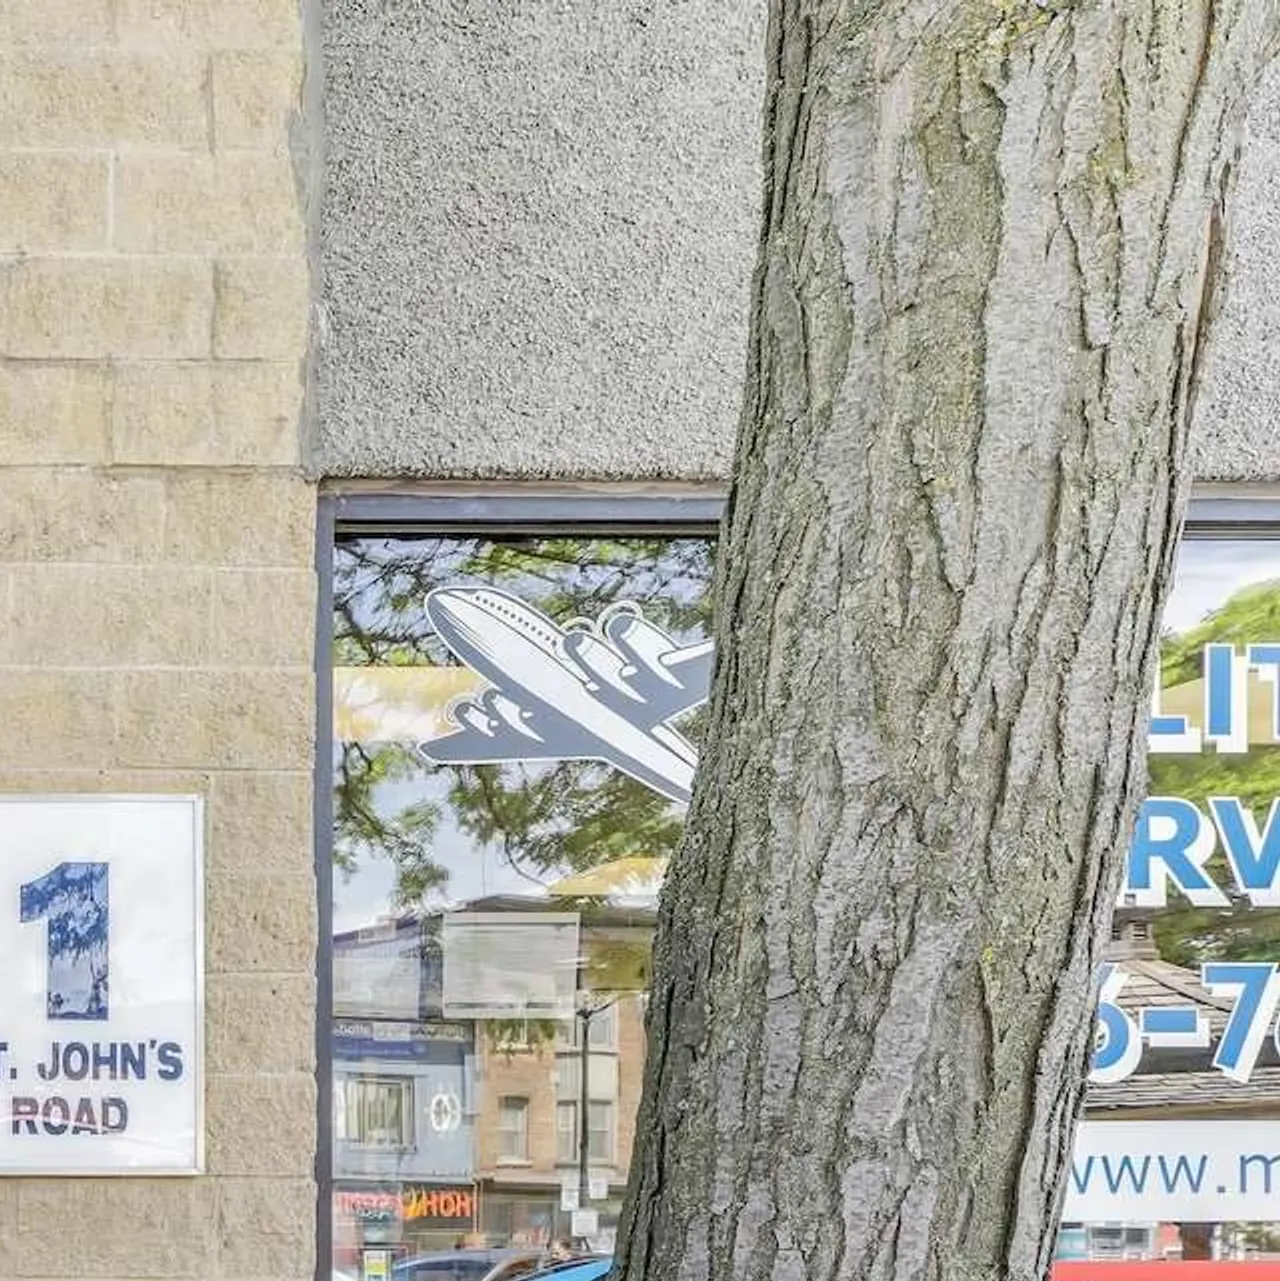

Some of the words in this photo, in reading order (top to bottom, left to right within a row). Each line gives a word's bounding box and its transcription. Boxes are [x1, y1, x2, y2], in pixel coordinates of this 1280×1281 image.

[19, 861, 109, 1020] 1
[37, 1040, 183, 1081] JOHN'S
[11, 1096, 129, 1136] ROAD
